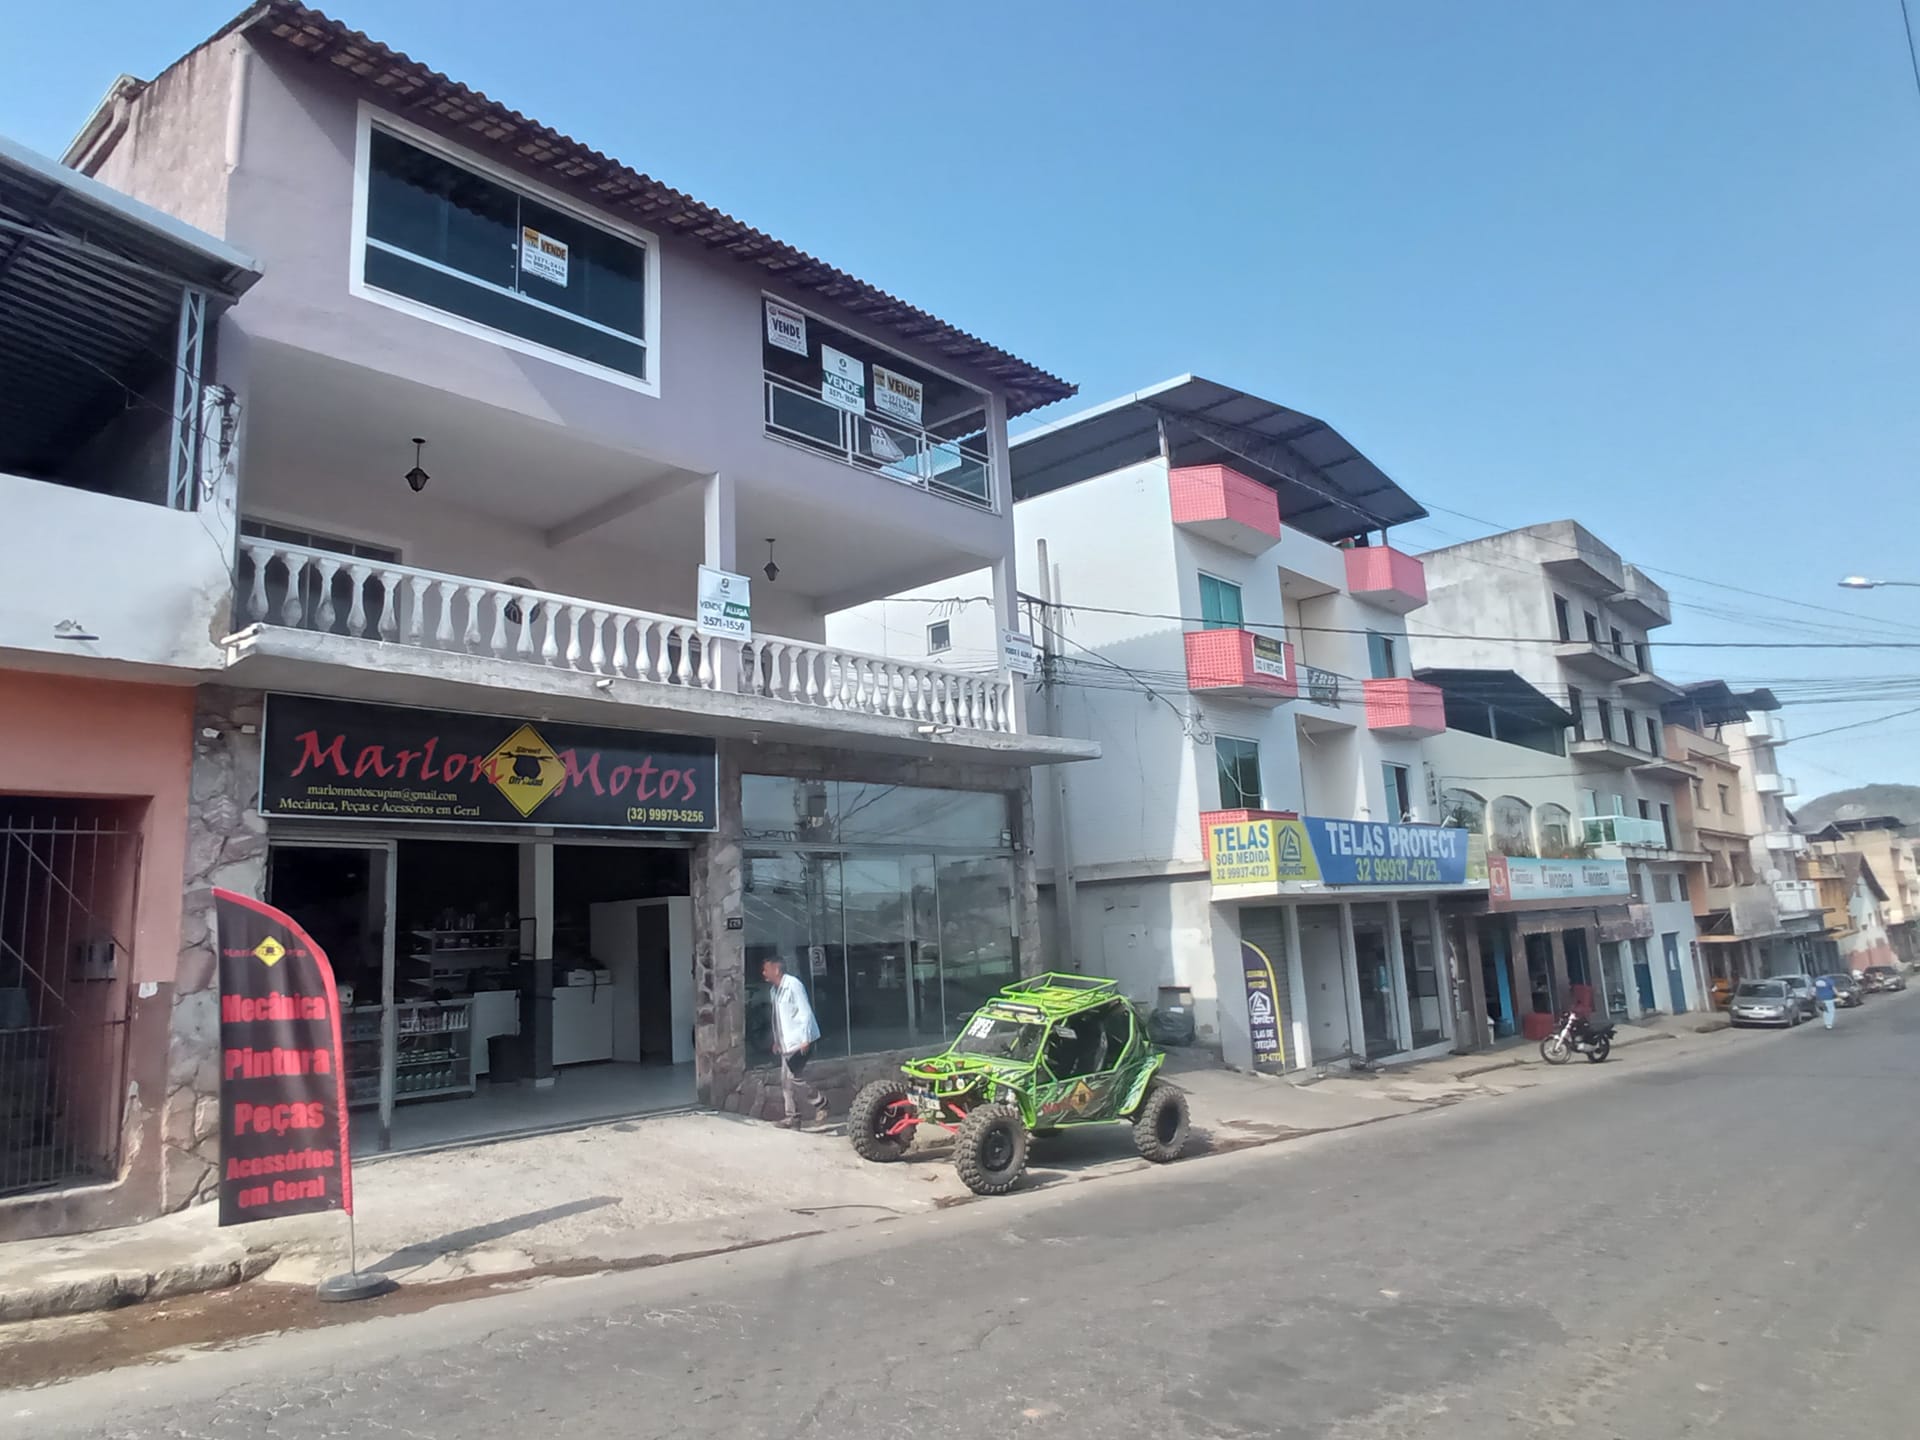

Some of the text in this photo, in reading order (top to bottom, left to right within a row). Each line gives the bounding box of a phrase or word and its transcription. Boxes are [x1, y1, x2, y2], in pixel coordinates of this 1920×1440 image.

[772, 317, 801, 340] VENDE
[825, 372, 861, 396] VENDE
[887, 374, 921, 402] VENDE
[703, 616, 745, 631] 3571-1559
[290, 729, 697, 802] Marlon Motos
[307, 784, 458, 802] marlonmotoscupim@gmail.com
[279, 798, 339, 813] Mecânica,
[341, 801, 371, 813] Peças
[381, 802, 434, 815] Acessórios
[436, 805, 451, 815] em
[453, 804, 480, 817] Geral
[627, 806, 704, 823] (32) 99979-5256
[1213, 823, 1270, 851] TELAS
[1325, 822, 1456, 859] TELAS PROTECT
[1215, 850, 1271, 866] SOB MEDIDA
[1355, 857, 1438, 881] 32 99937-4723
[1216, 866, 1270, 880] 32 99937-4723
[222, 991, 327, 1023] Mecânica
[225, 1047, 331, 1080] Pintura
[234, 1100, 325, 1137] Peças
[226, 1148, 335, 1181] Acessórios
[238, 1175, 326, 1208] em Geral
